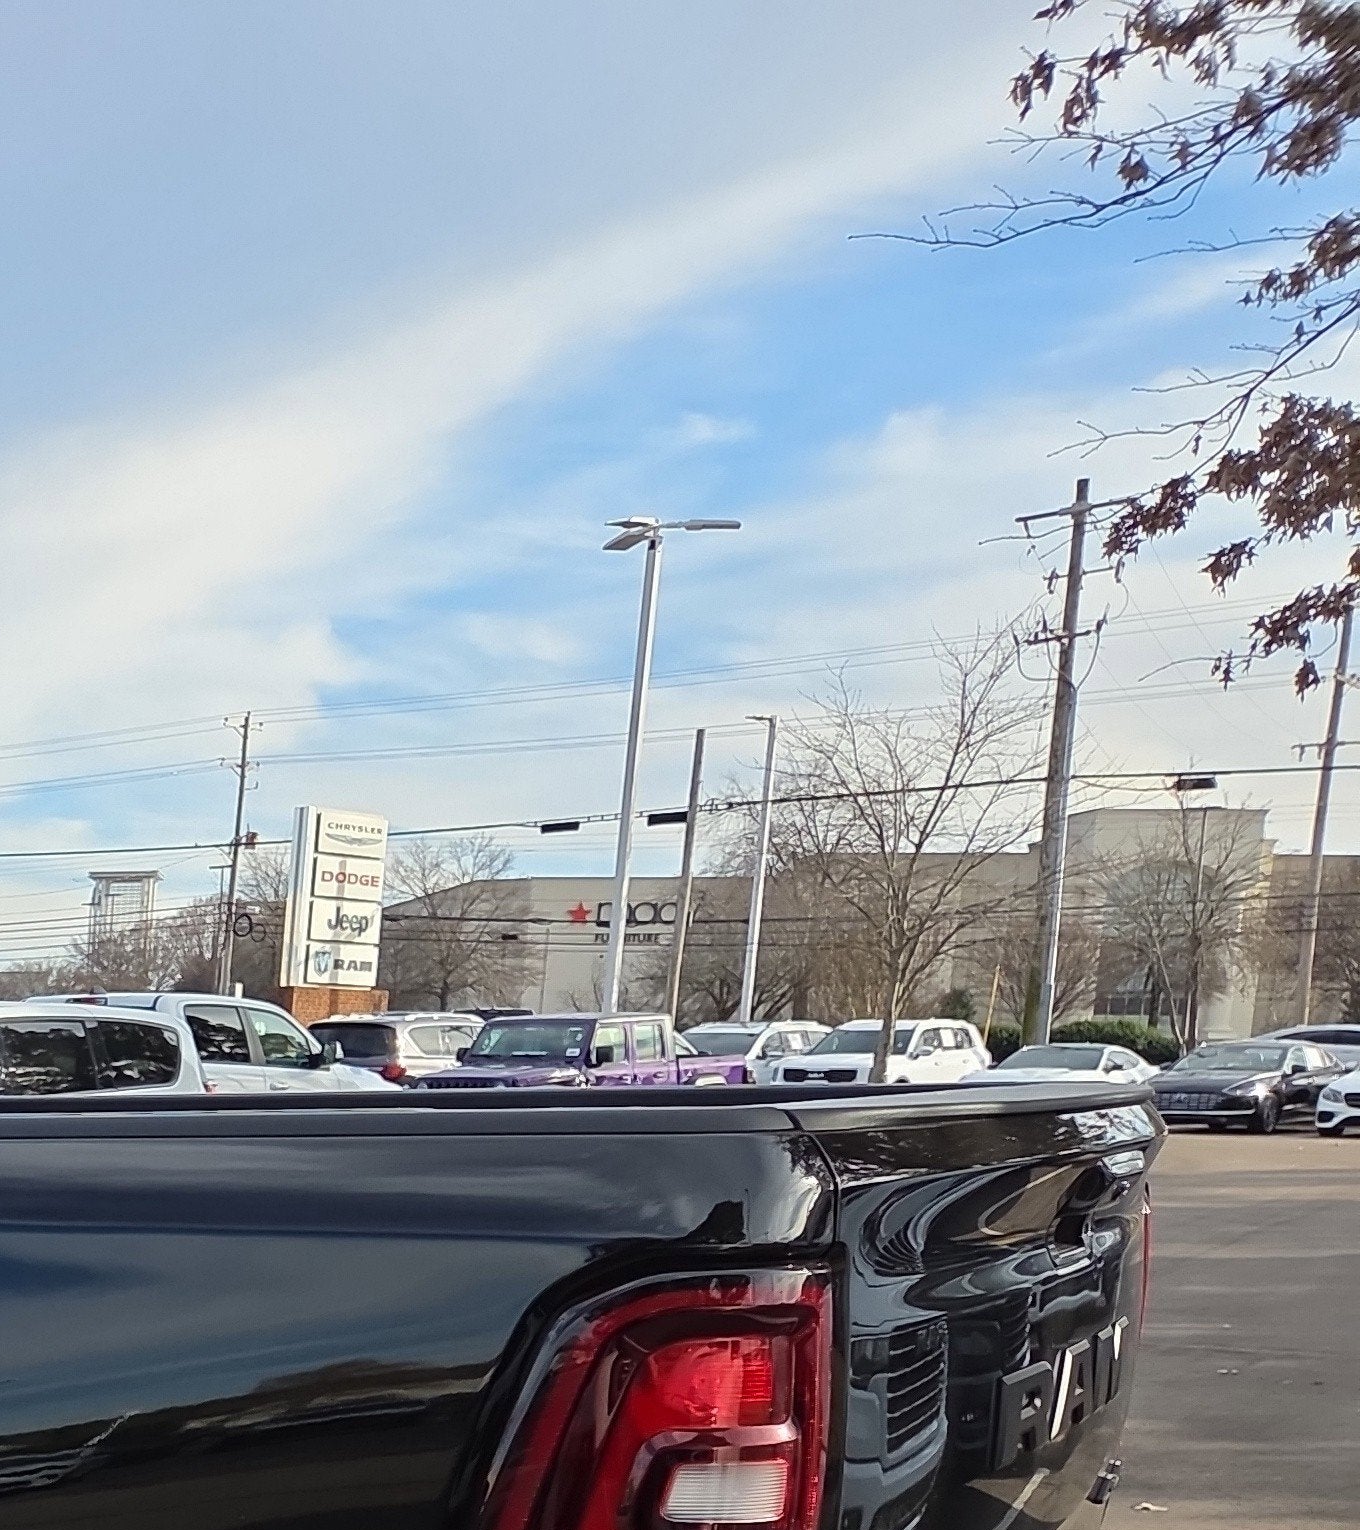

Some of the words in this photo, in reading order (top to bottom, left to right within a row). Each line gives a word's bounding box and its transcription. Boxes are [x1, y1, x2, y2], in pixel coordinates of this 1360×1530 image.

[327, 821, 383, 835] CHRYSLER
[320, 870, 380, 888] DODGE
[327, 906, 369, 938] Jeep
[333, 958, 373, 973] RAM
[992, 1315, 1130, 1472] RAM
